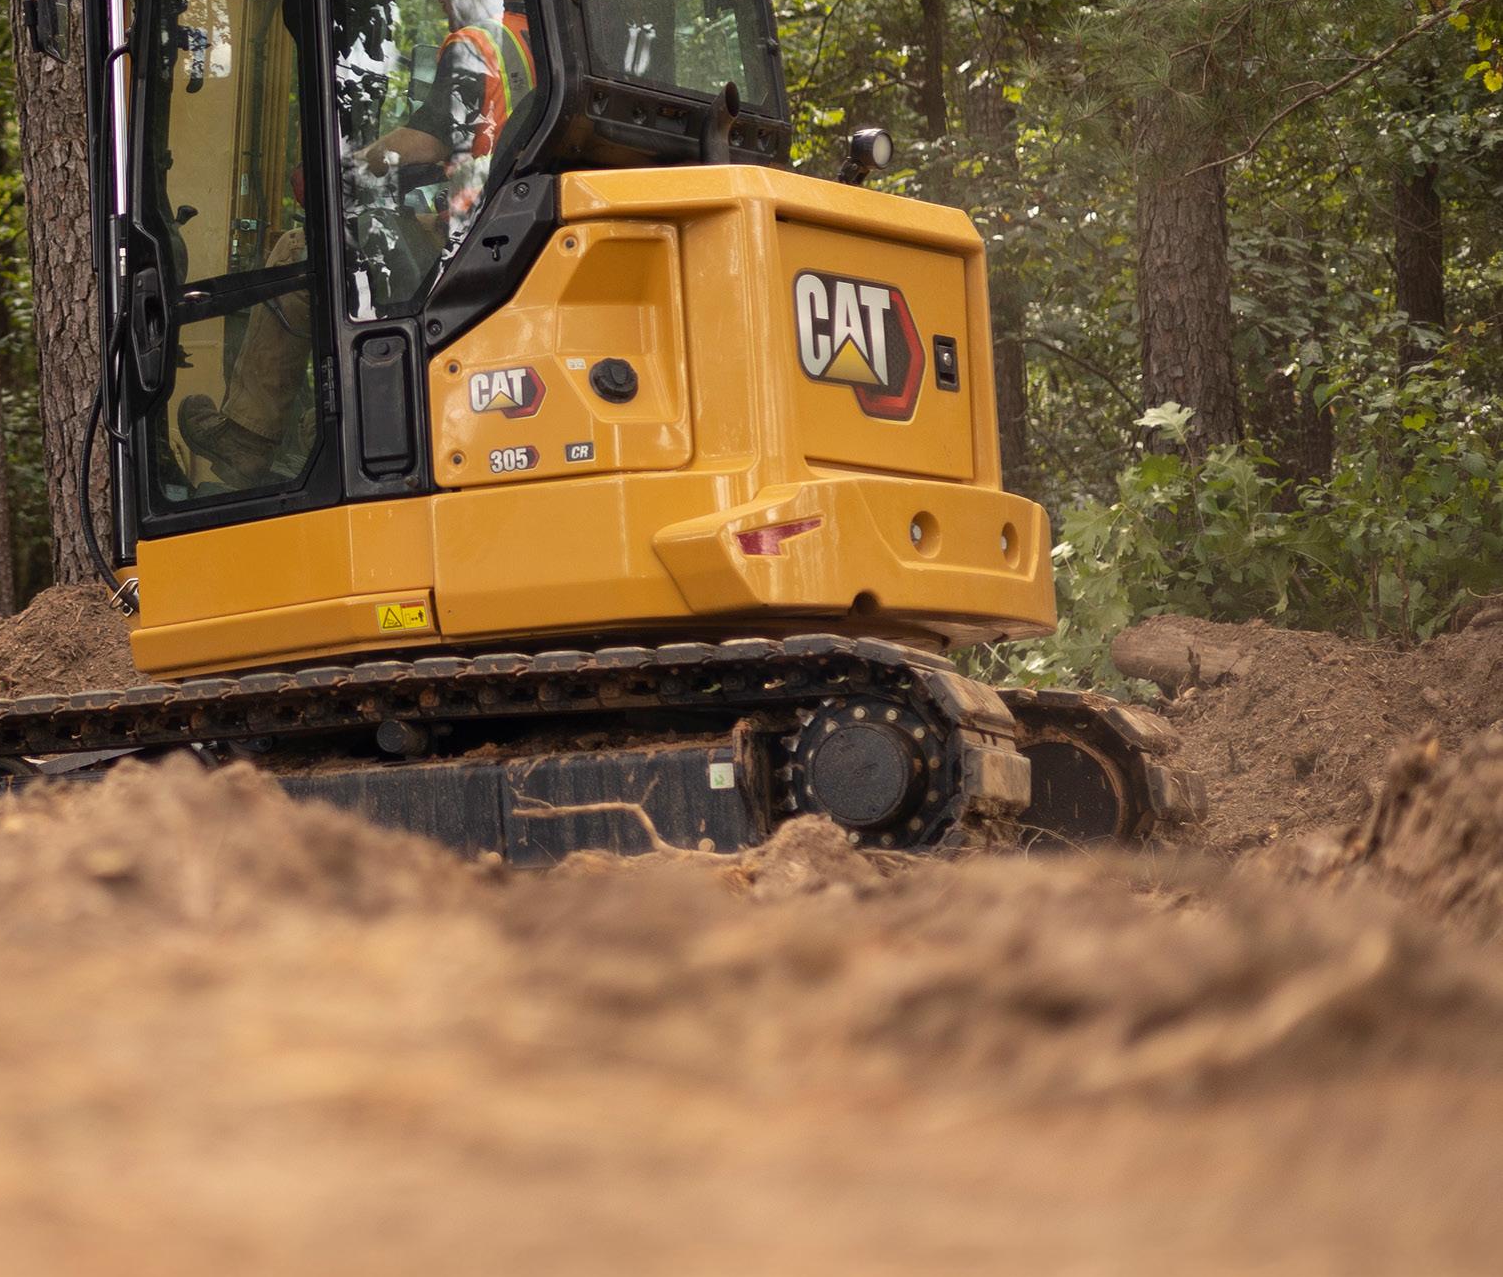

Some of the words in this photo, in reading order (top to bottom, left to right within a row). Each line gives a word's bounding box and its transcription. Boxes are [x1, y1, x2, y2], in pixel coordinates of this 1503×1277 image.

[796, 274, 891, 386] CAT
[471, 368, 526, 412] CAT
[490, 448, 528, 473] 305
[571, 445, 589, 460] CR
